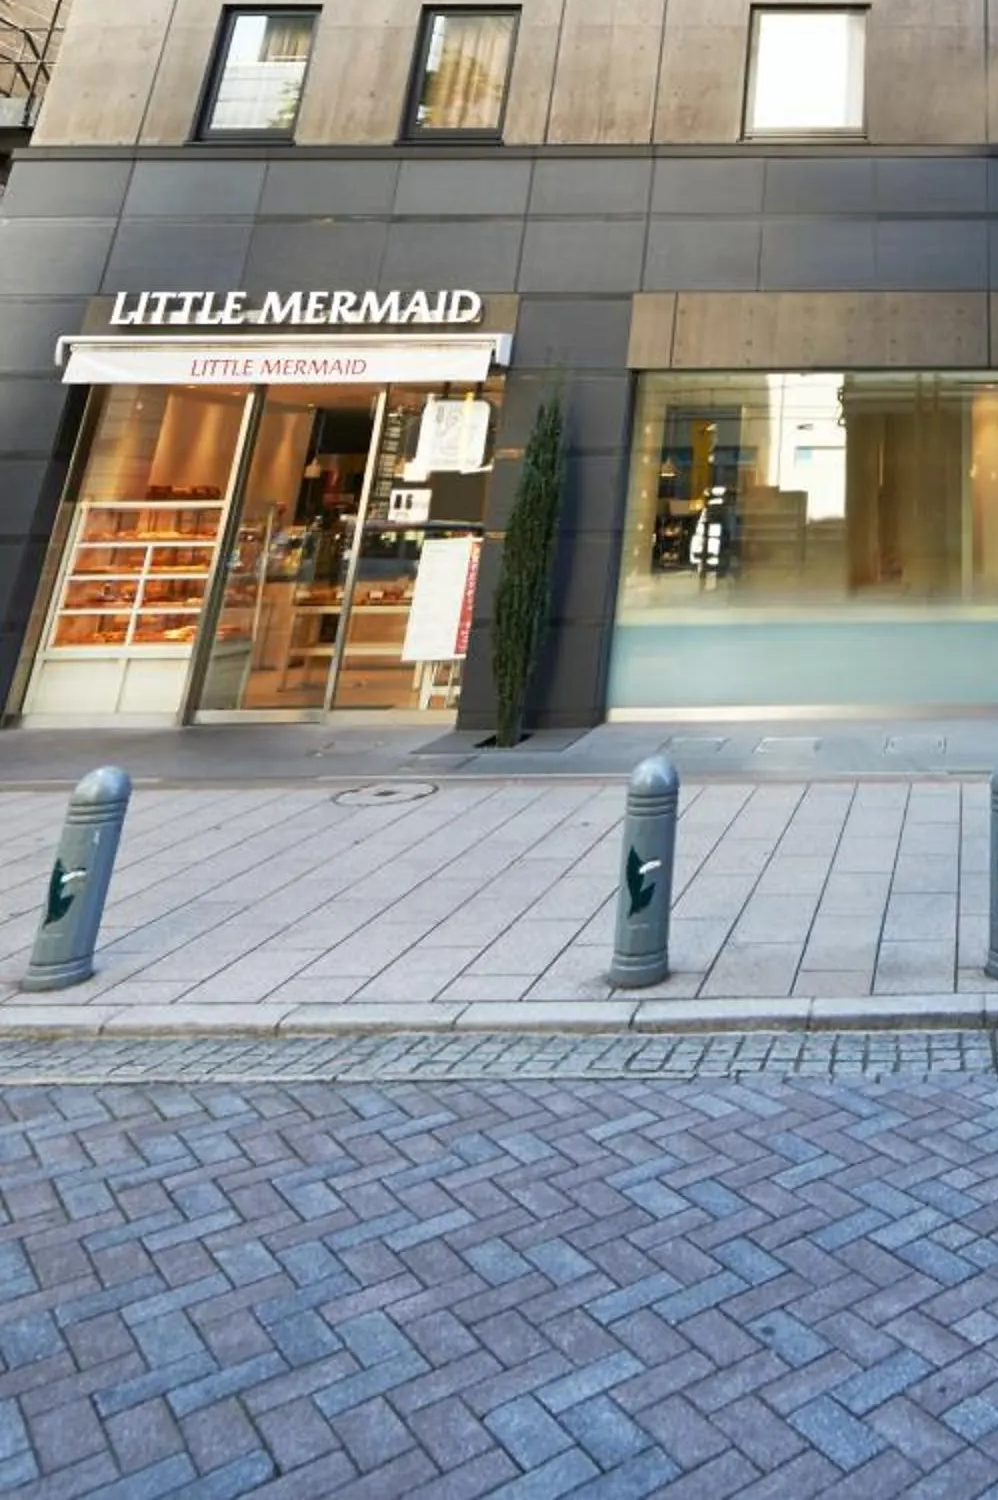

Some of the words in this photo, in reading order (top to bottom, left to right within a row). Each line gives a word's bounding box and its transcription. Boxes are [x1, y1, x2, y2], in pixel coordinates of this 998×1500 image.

[110, 291, 246, 325] LITTLE
[256, 289, 482, 324] MERMAID
[190, 358, 253, 377] LITTLE
[260, 357, 367, 376] MERMAID
